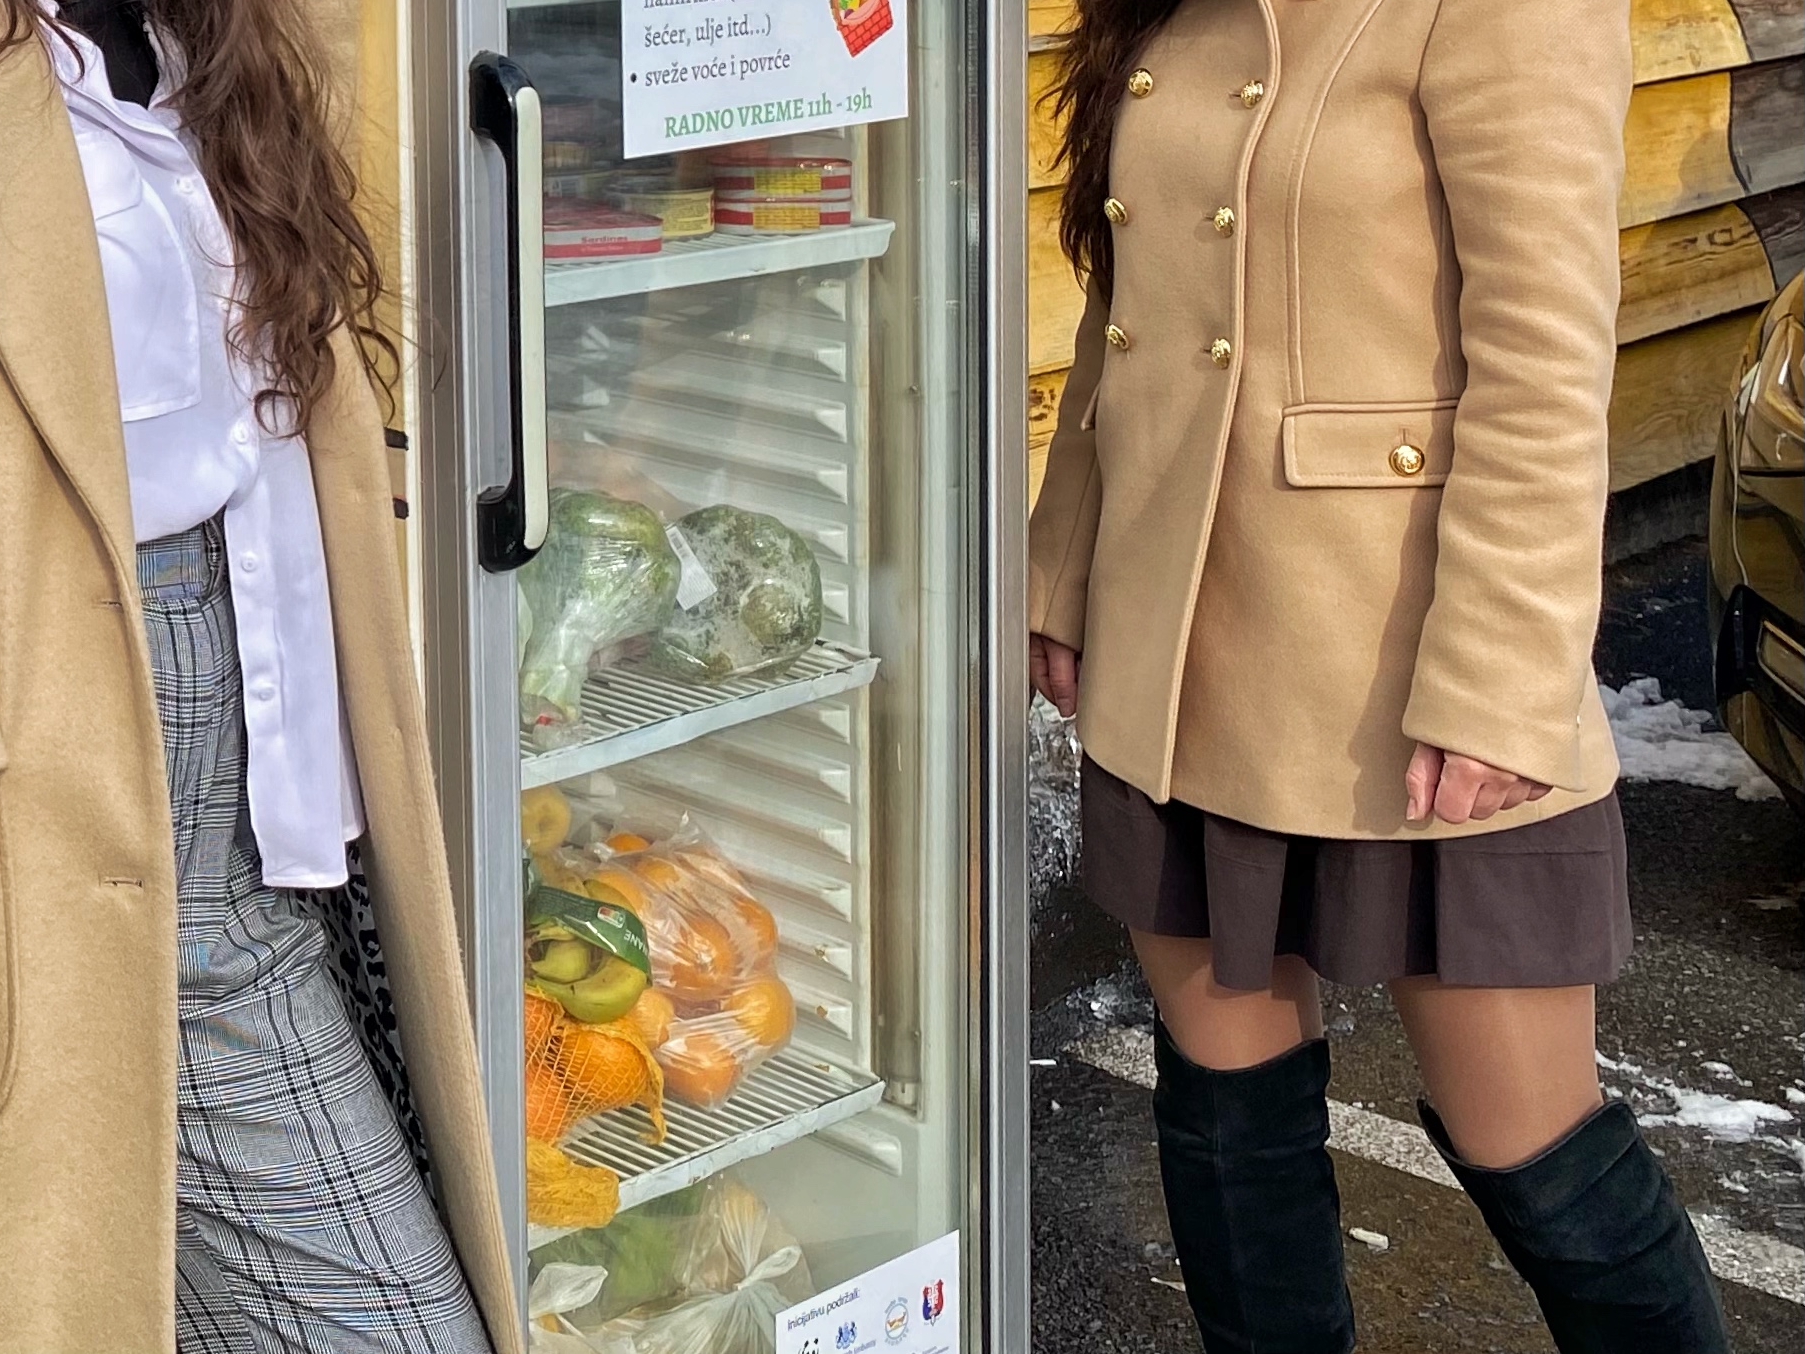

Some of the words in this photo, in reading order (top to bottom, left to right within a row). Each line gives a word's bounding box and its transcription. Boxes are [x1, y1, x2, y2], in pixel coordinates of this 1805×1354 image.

[644, 24, 691, 48] šećer,
[695, 18, 723, 45] ulje
[645, 62, 688, 87] sveže
[692, 56, 727, 81] voće
[730, 55, 735, 76] i
[740, 48, 791, 80] povrće
[665, 109, 734, 139] RADNO
[737, 98, 804, 125] VREME
[808, 92, 832, 118] 11h
[846, 86, 873, 113] 19h
